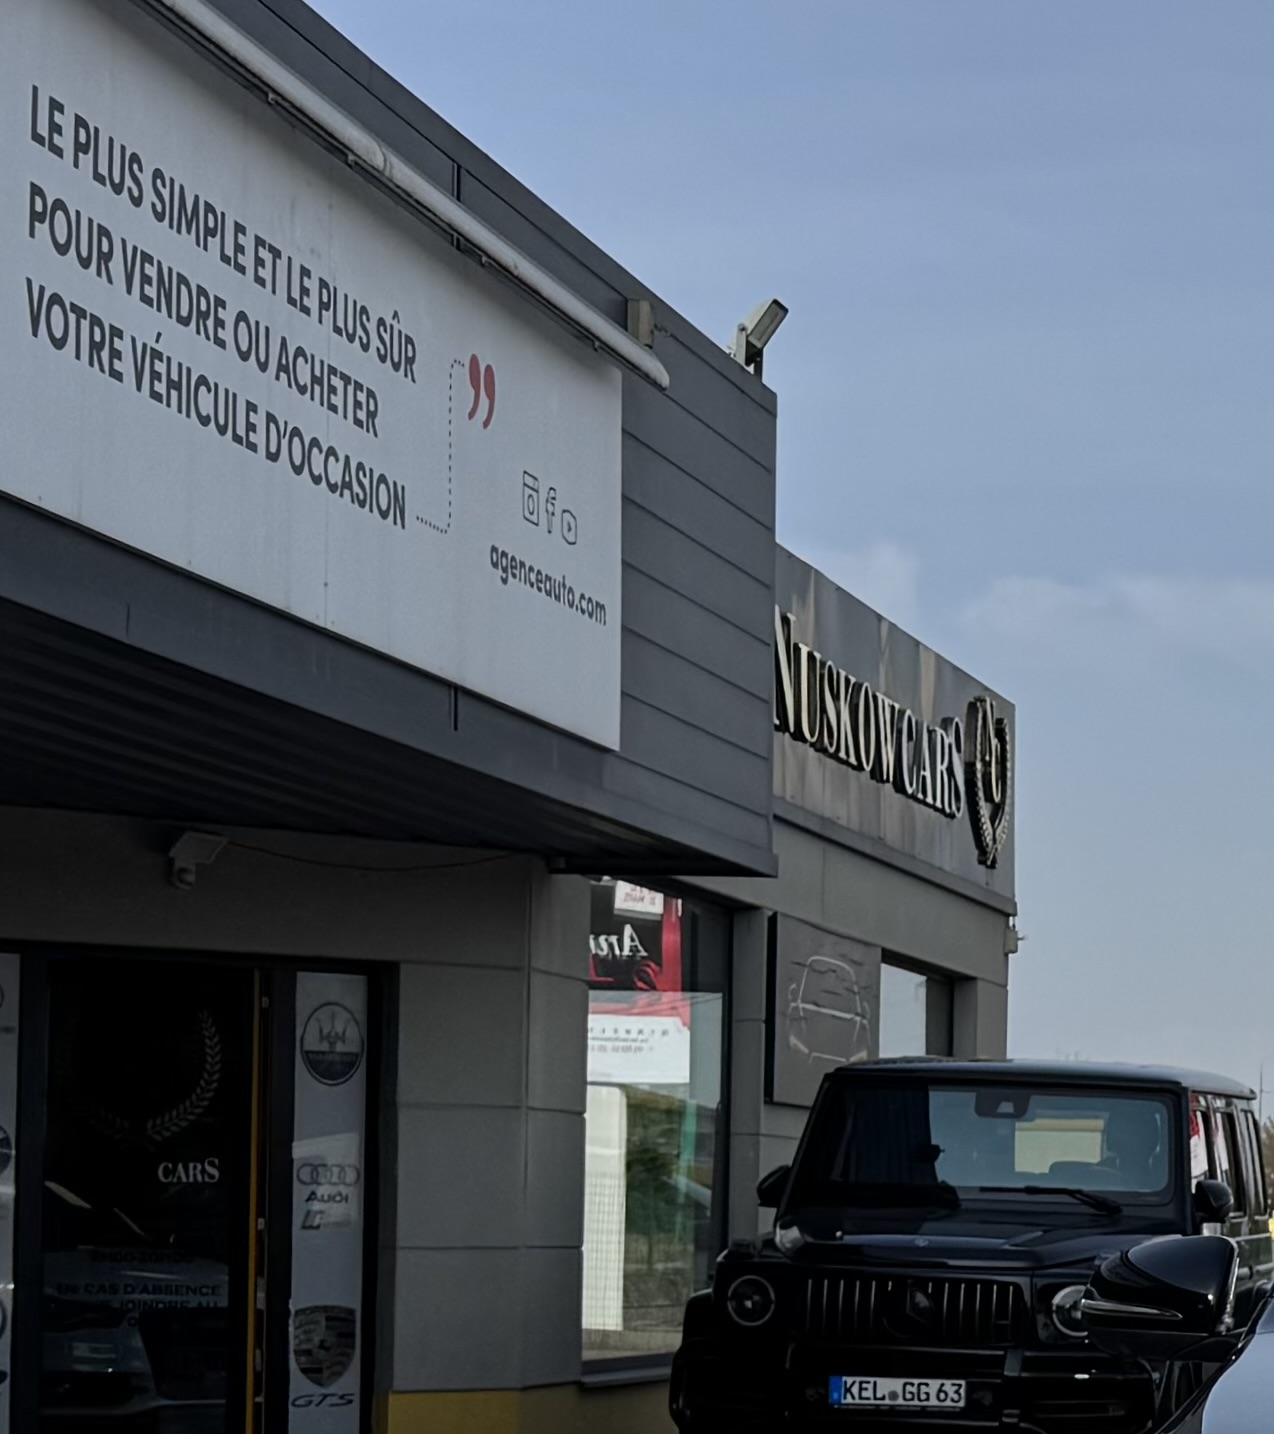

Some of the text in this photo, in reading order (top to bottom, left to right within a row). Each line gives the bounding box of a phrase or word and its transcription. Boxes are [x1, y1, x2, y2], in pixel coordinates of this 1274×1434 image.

[30, 85, 417, 384] LE PLUS SIMPLE ET LE PLUS SÛR
[28, 181, 378, 439] POUR VENDRE OU ACHETER
[26, 277, 406, 530] VOTRE VÉHICULE D'OCCASION
[489, 542, 607, 627] agenceauto.com
[156, 1157, 220, 1184] CARS
[290, 1391, 355, 1408] GTS
[842, 1380, 963, 1404] KEL GG 63
